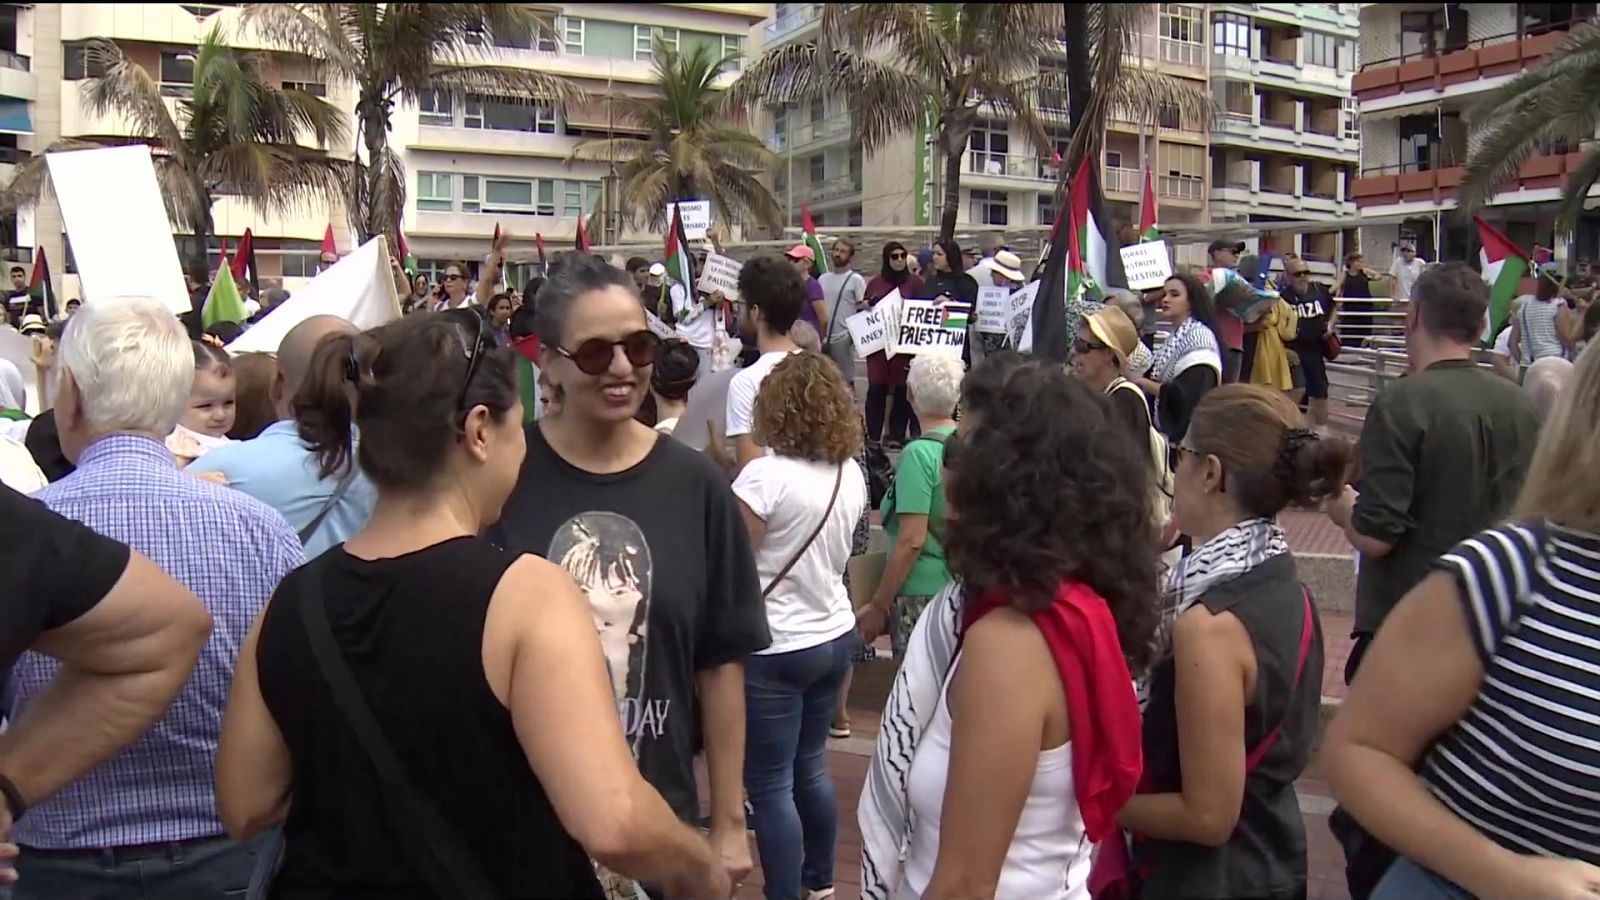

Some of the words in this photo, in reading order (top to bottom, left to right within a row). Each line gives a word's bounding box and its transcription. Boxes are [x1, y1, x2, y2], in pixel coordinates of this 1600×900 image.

[906, 307, 942, 325] FREE
[898, 325, 964, 346] PALESTINA
[623, 697, 671, 740] DAY
